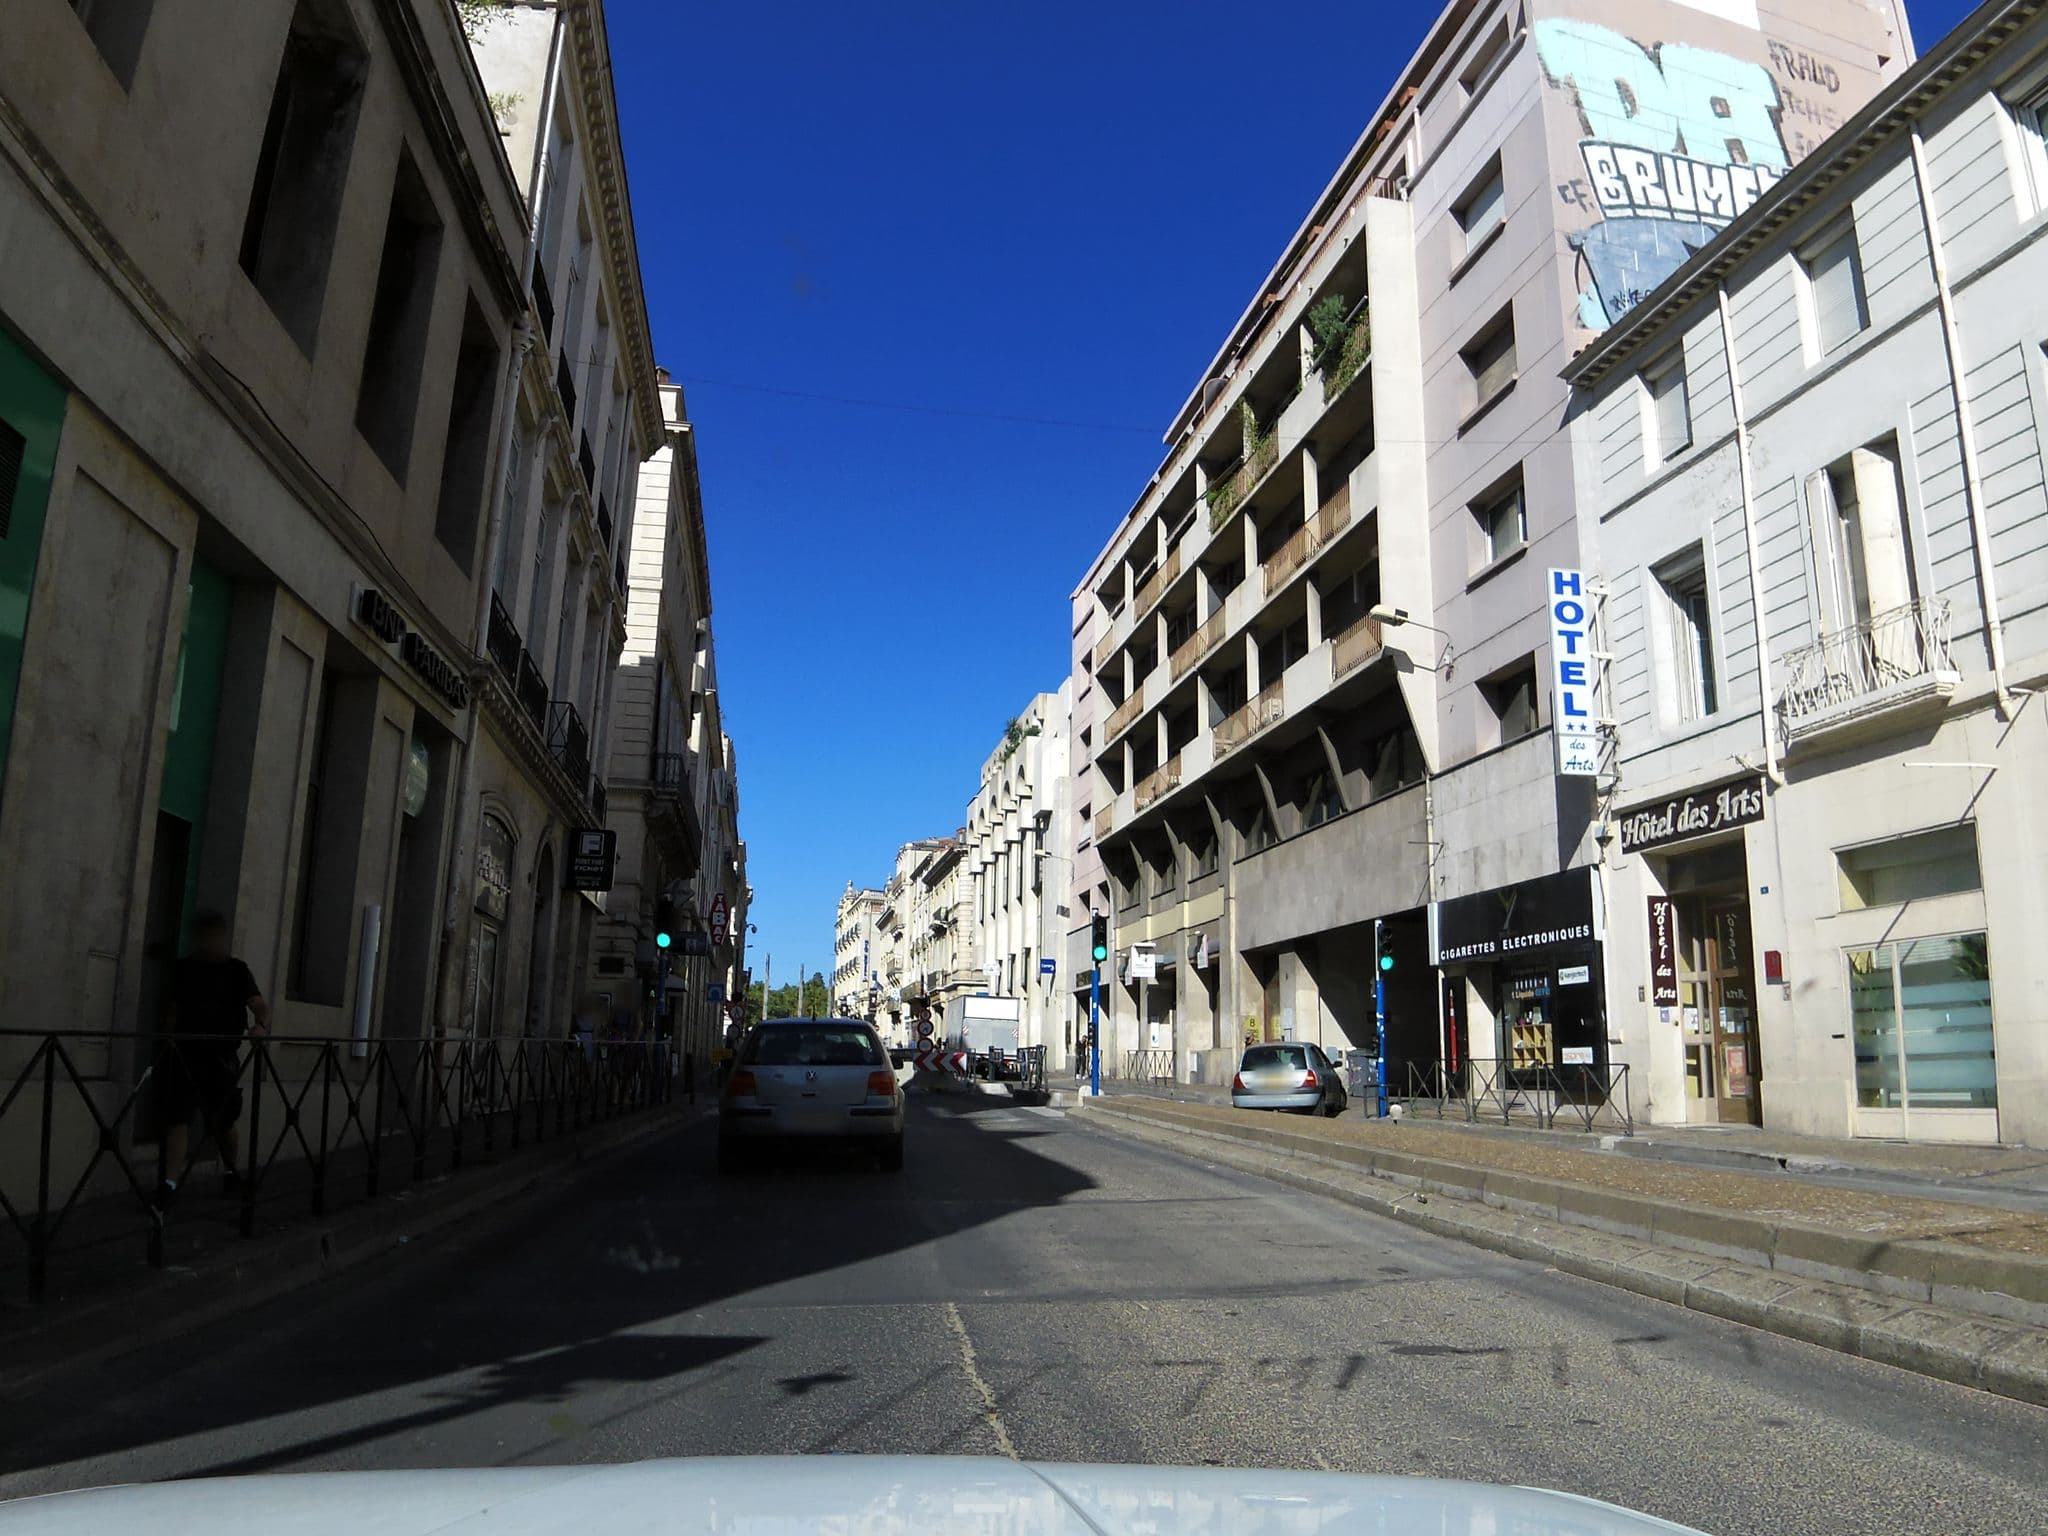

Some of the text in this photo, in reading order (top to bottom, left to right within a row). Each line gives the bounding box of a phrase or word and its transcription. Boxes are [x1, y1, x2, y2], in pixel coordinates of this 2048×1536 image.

[1553, 571, 1587, 717] HOTEL
[1569, 738, 1586, 751] des
[1564, 755, 1595, 772] Arts
[1622, 787, 1761, 849] Hôtel des Arts
[712, 893, 728, 944] TABAC
[1440, 925, 1590, 961] CIGARETTES ELECTRONIQUES
[1656, 964, 1672, 977] des
[1654, 986, 1676, 1000] Arts
